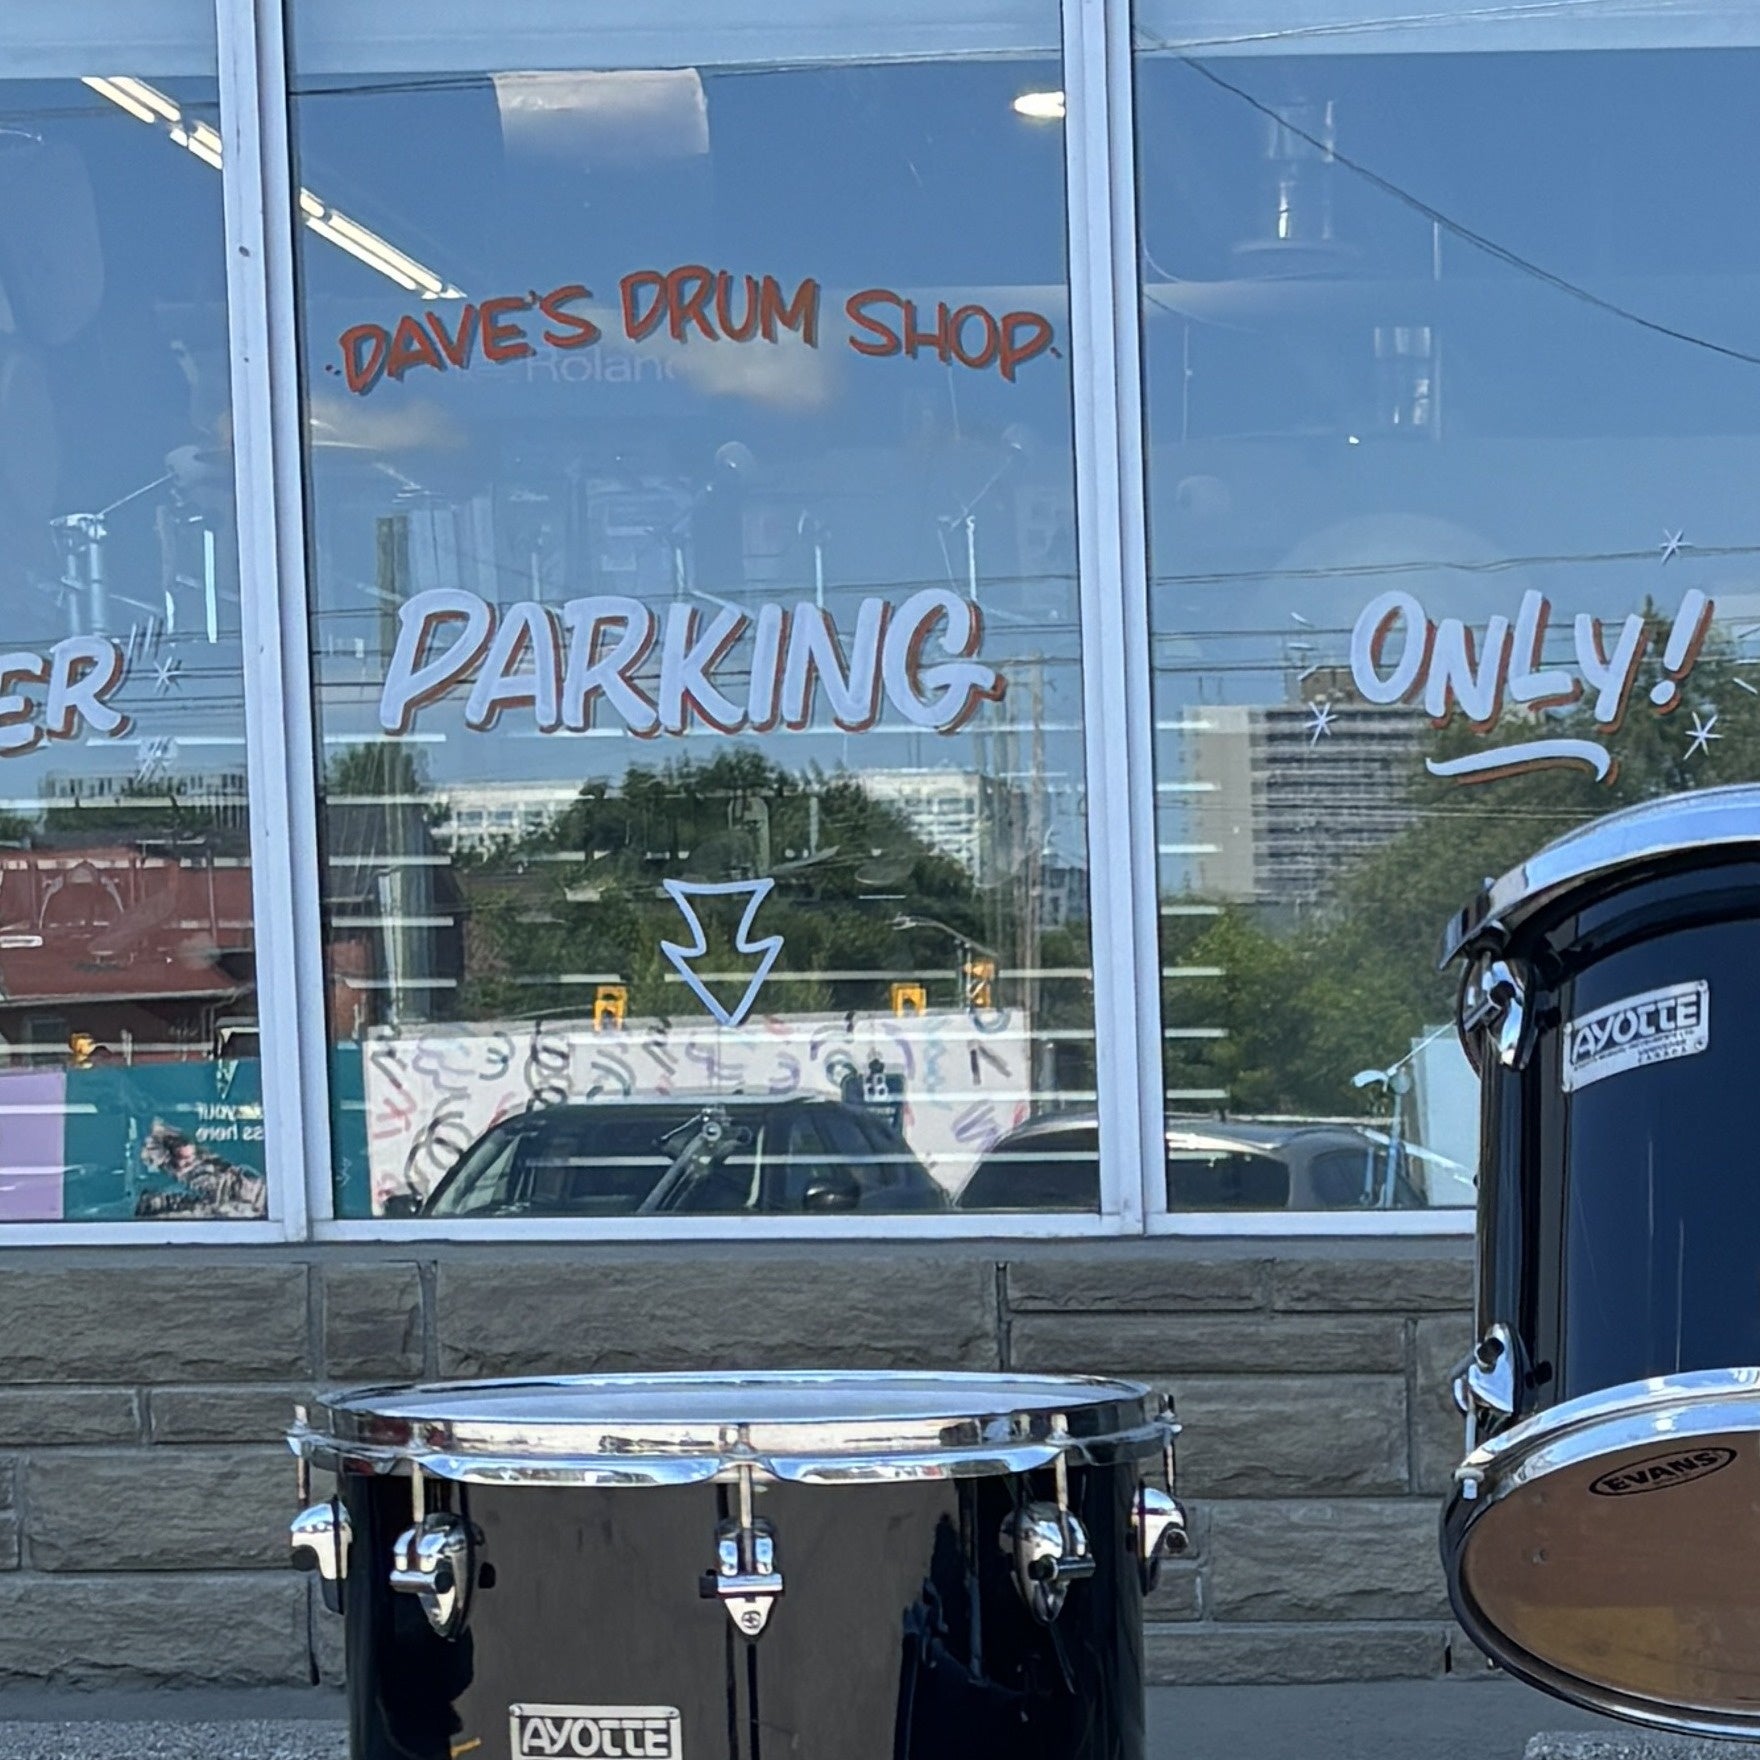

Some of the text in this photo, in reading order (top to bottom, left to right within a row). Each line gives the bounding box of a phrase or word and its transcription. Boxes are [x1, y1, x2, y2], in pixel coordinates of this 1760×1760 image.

[339, 284, 602, 396] DAVE'S
[619, 264, 819, 349] DRUM
[379, 588, 1008, 740] PARKING
[1350, 588, 1715, 735] ONLY!
[1571, 992, 1698, 1065] AYOTTE
[1601, 1451, 1720, 1492] EVANS
[522, 1717, 669, 1757] AYOTTE
